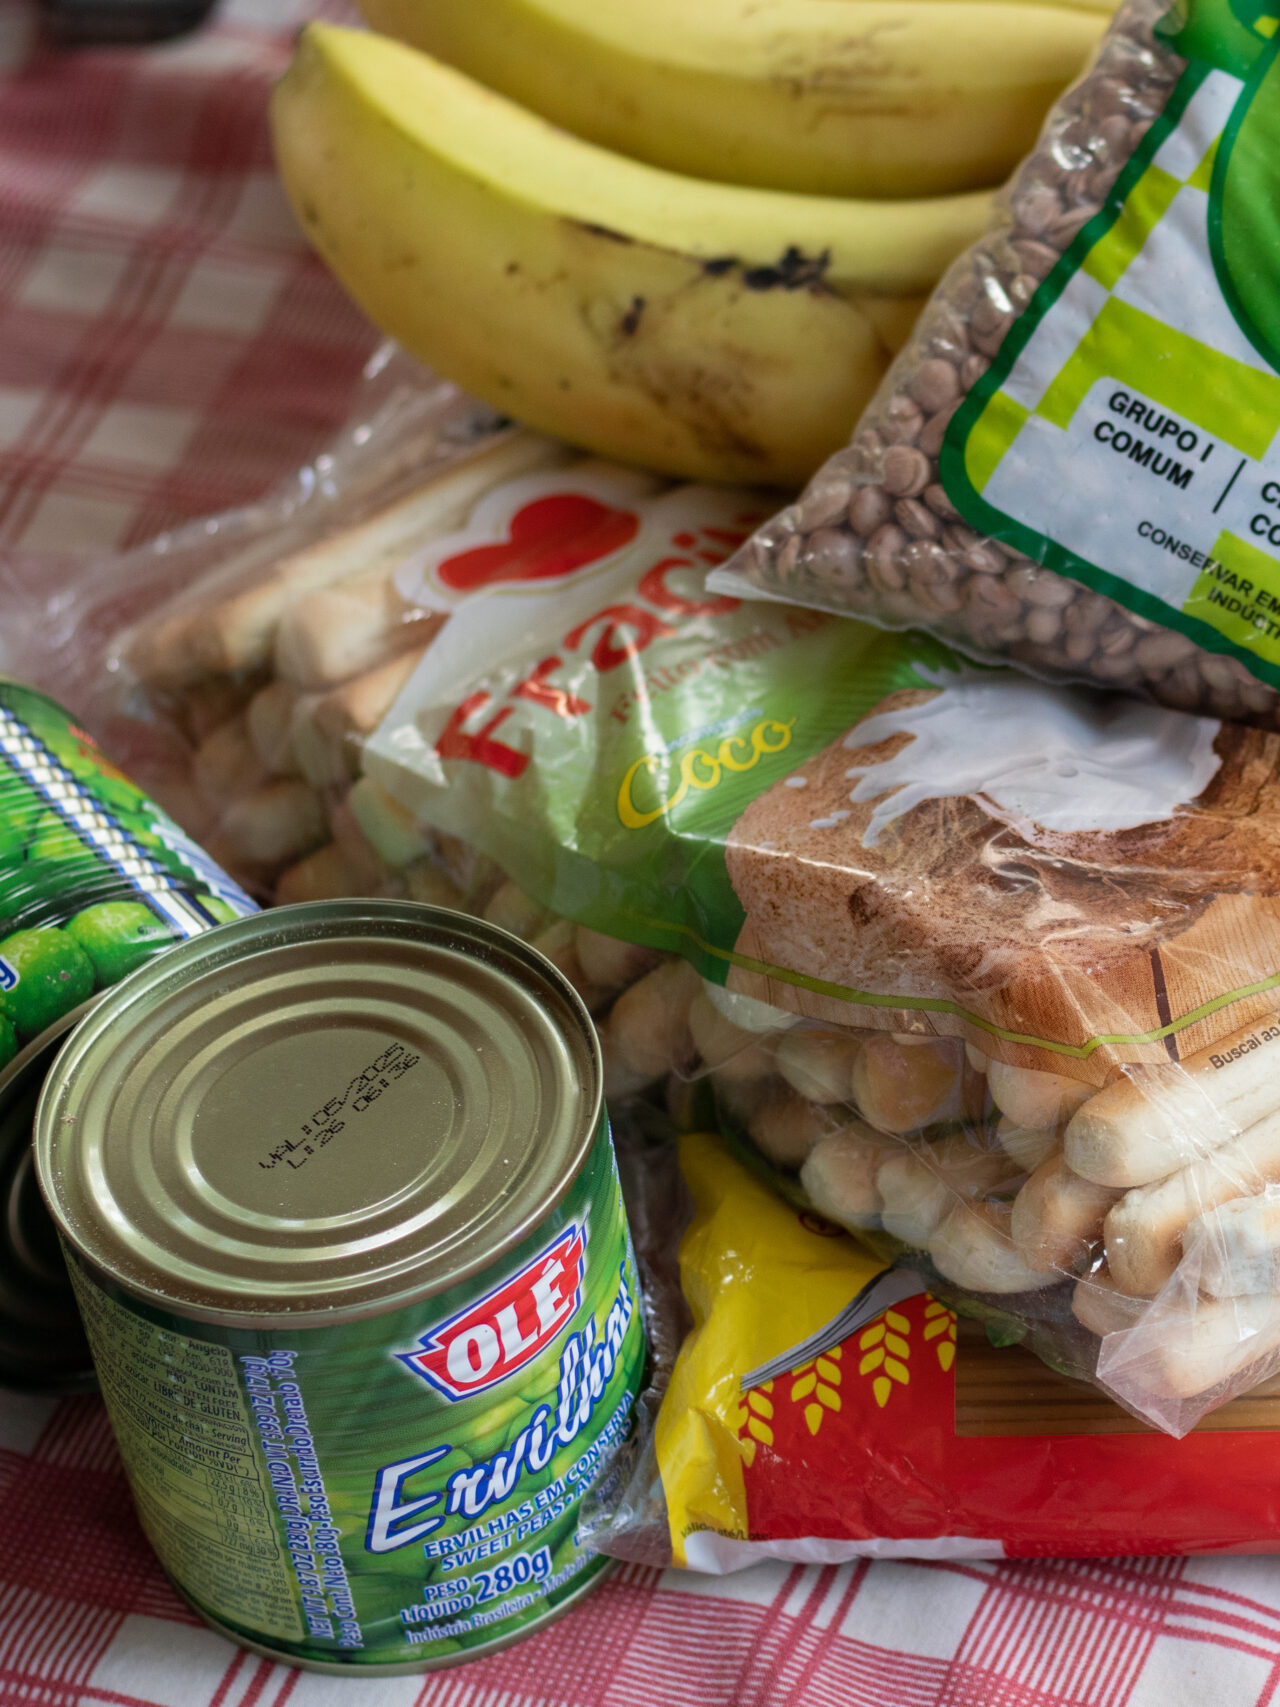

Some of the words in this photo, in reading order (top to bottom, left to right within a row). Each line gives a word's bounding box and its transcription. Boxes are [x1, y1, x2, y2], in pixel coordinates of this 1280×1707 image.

[1108, 391, 1199, 452] GRUPO
[1199, 443, 1214, 463] I
[1093, 421, 1194, 490] COMUM
[1137, 521, 1254, 597] CONSERVAR
[617, 716, 797, 829] Coco
[1208, 1033, 1262, 1070] Buscai
[1260, 1026, 1280, 1043] ao
[446, 1258, 571, 1384] OLÉ
[189, 1340, 228, 1357] Angelo
[267, 1350, 299, 1380] 170g
[200, 1402, 245, 1422] GLUTEN.
[179, 1436, 221, 1457] Amount
[222, 1451, 242, 1464] Per
[211, 1428, 248, 1448] Serving
[262, 1439, 289, 1460] WT
[424, 1500, 534, 1558] ERVILHAS
[534, 1477, 566, 1511] EM
[565, 1389, 635, 1486] CONSERVA
[441, 1530, 518, 1572] SWEET
[516, 1496, 565, 1541] PEAS
[424, 1577, 471, 1602] PESO
[472, 1545, 554, 1604] 280g
[301, 1595, 329, 1616] WT
[401, 1594, 475, 1624] LÍQUIDO
[405, 1619, 473, 1645] Indústria
[471, 1593, 535, 1629] Brasileira
[308, 1617, 335, 1639] NET
[338, 1620, 365, 1648] Peso
